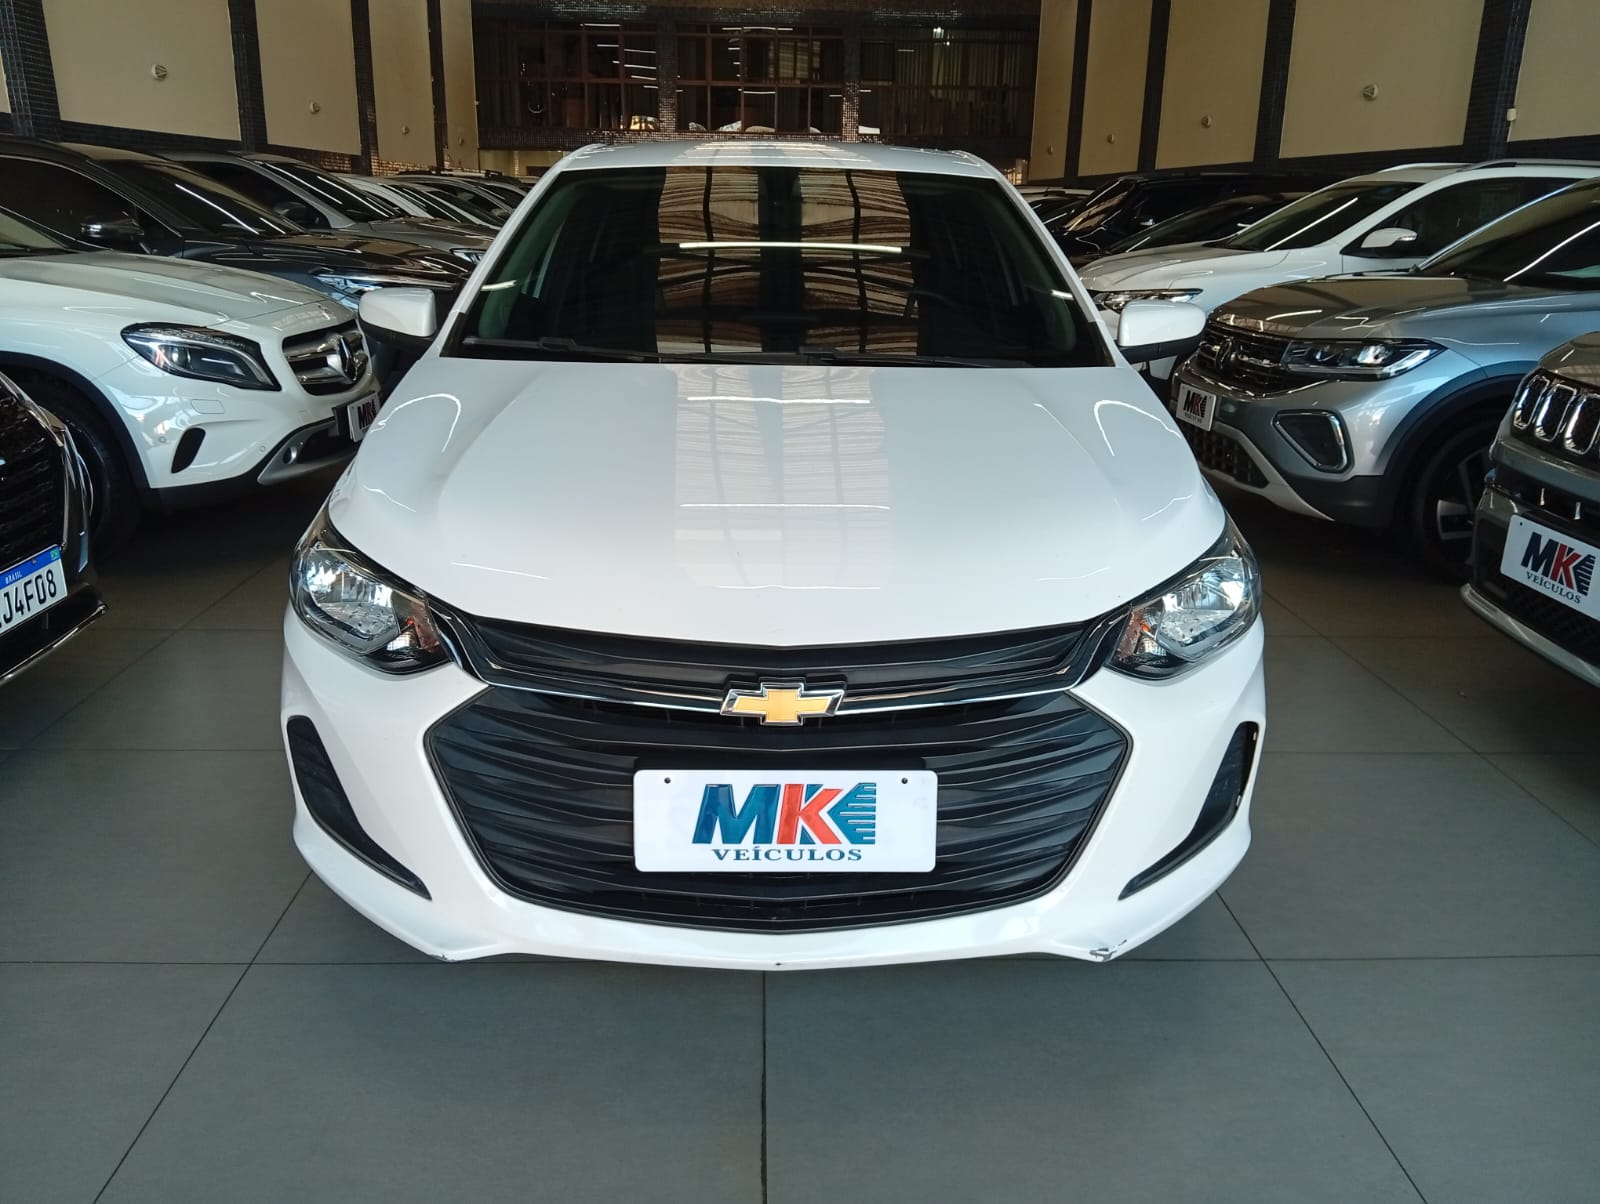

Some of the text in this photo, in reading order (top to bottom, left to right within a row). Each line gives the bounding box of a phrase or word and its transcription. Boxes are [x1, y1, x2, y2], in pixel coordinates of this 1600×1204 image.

[0, 569, 56, 628] J4F08
[1526, 571, 1581, 604] VEÍCULOS
[712, 846, 862, 861] VEÍCULOS
